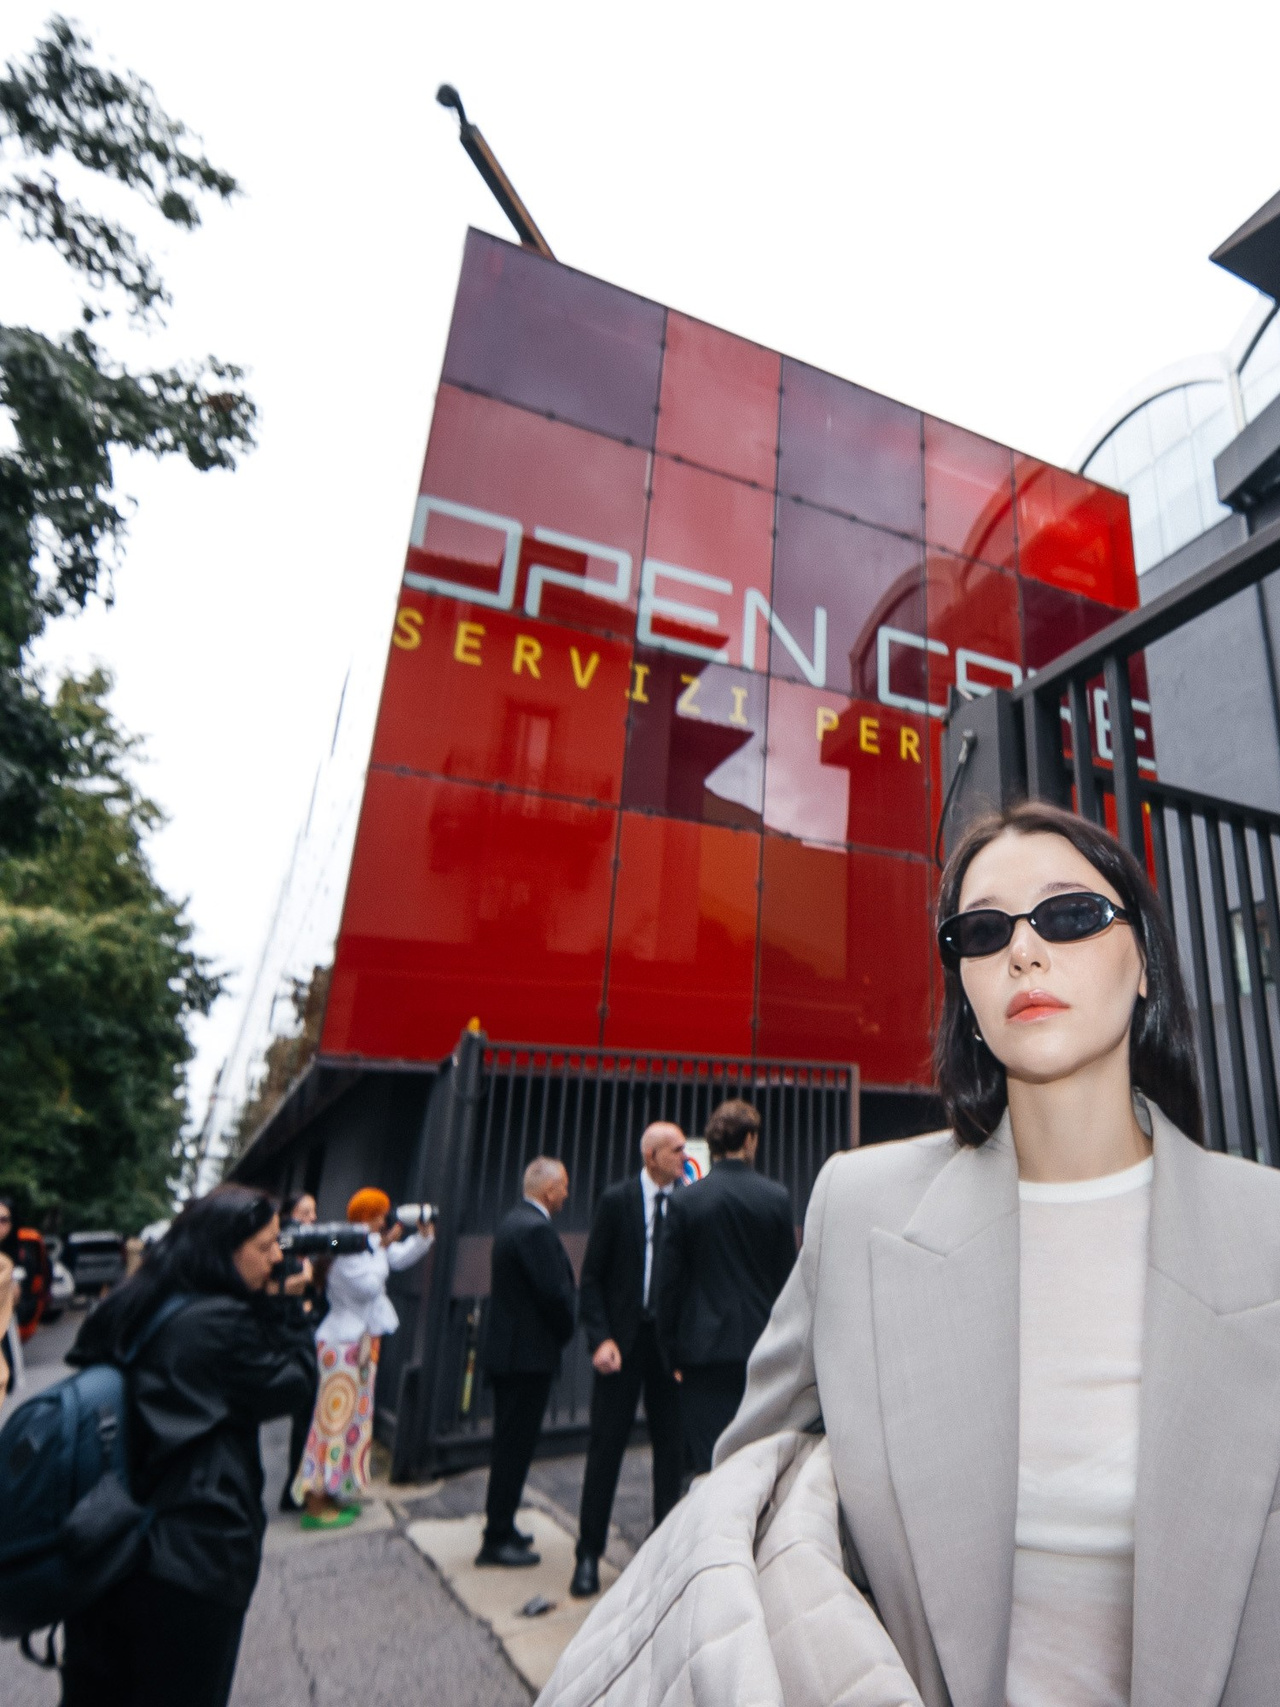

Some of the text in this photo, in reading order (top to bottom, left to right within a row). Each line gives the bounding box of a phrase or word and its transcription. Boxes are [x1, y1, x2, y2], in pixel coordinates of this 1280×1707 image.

[402, 494, 828, 688] OPEN
[391, 606, 921, 764] SERVIZI PER
